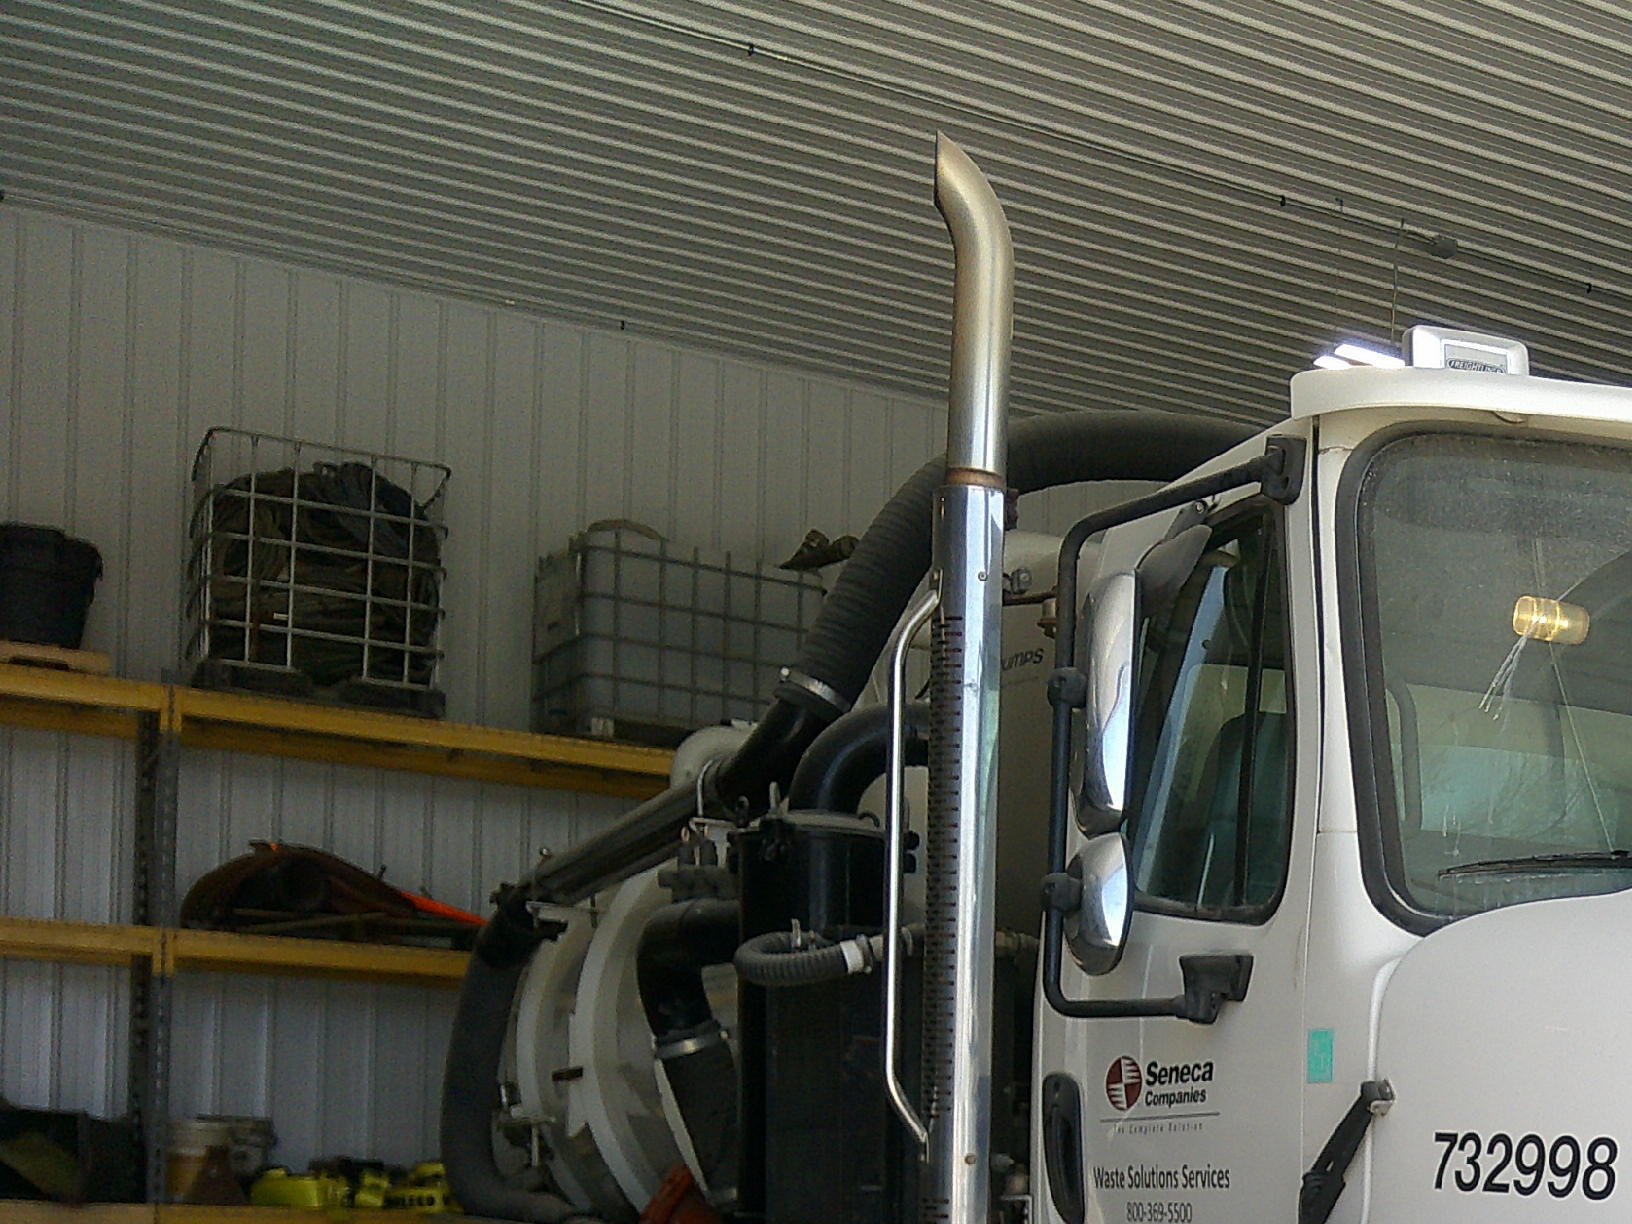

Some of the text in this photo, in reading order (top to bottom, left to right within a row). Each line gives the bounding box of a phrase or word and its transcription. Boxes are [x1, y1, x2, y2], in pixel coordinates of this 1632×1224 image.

[1145, 1060, 1214, 1086] Seneca
[1145, 1086, 1206, 1109] Companies
[1093, 1163, 1230, 1189] Waste Solutions Services
[1434, 1132, 1618, 1200] 732998
[1126, 1202, 1193, 1224] 800-369-5500
